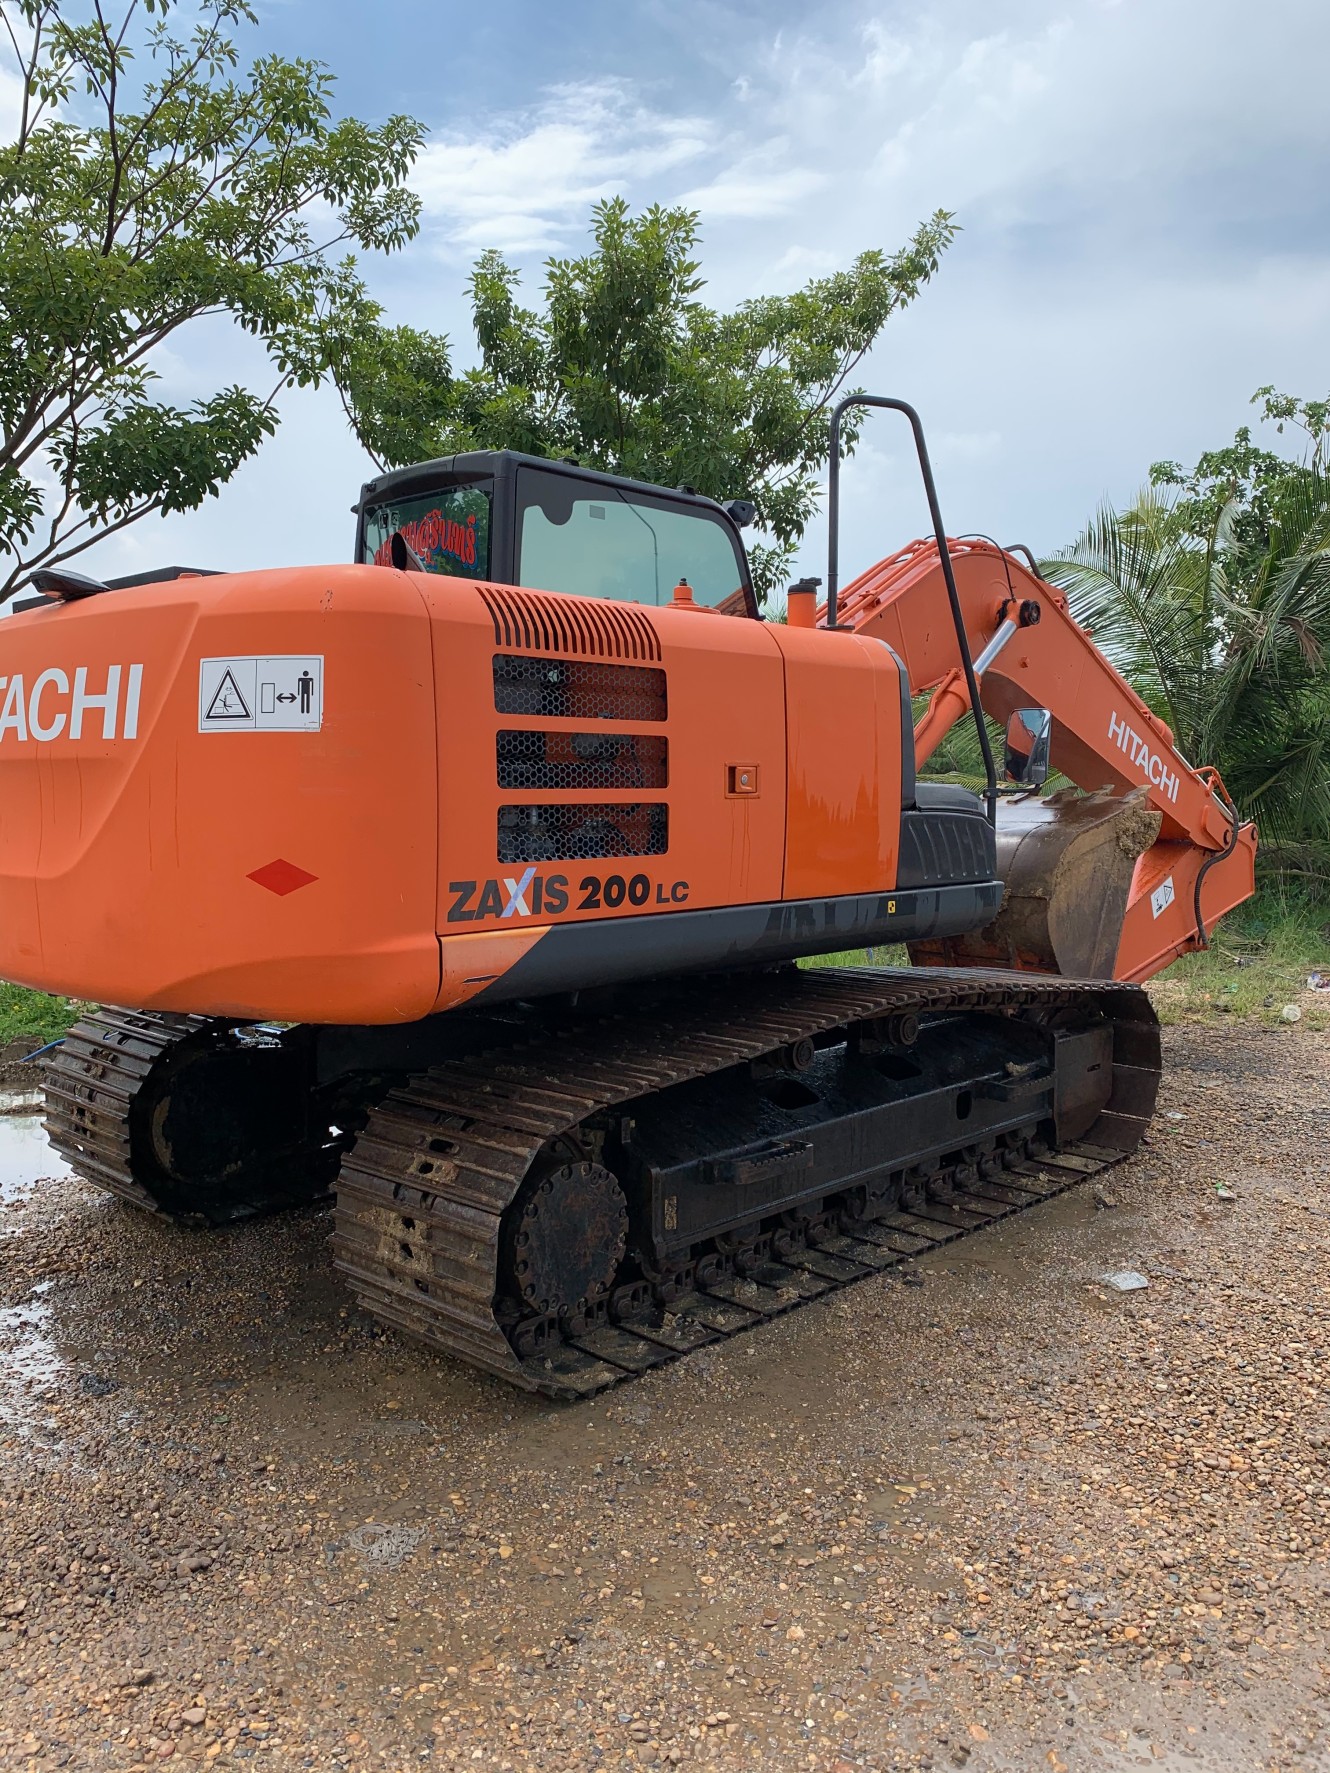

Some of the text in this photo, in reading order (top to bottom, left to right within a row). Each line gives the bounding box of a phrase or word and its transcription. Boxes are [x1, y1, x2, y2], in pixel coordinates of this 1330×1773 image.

[0, 663, 144, 742] ACHI
[1107, 710, 1180, 804] HITACHI
[447, 867, 689, 922] ZAXIS 200 LC
